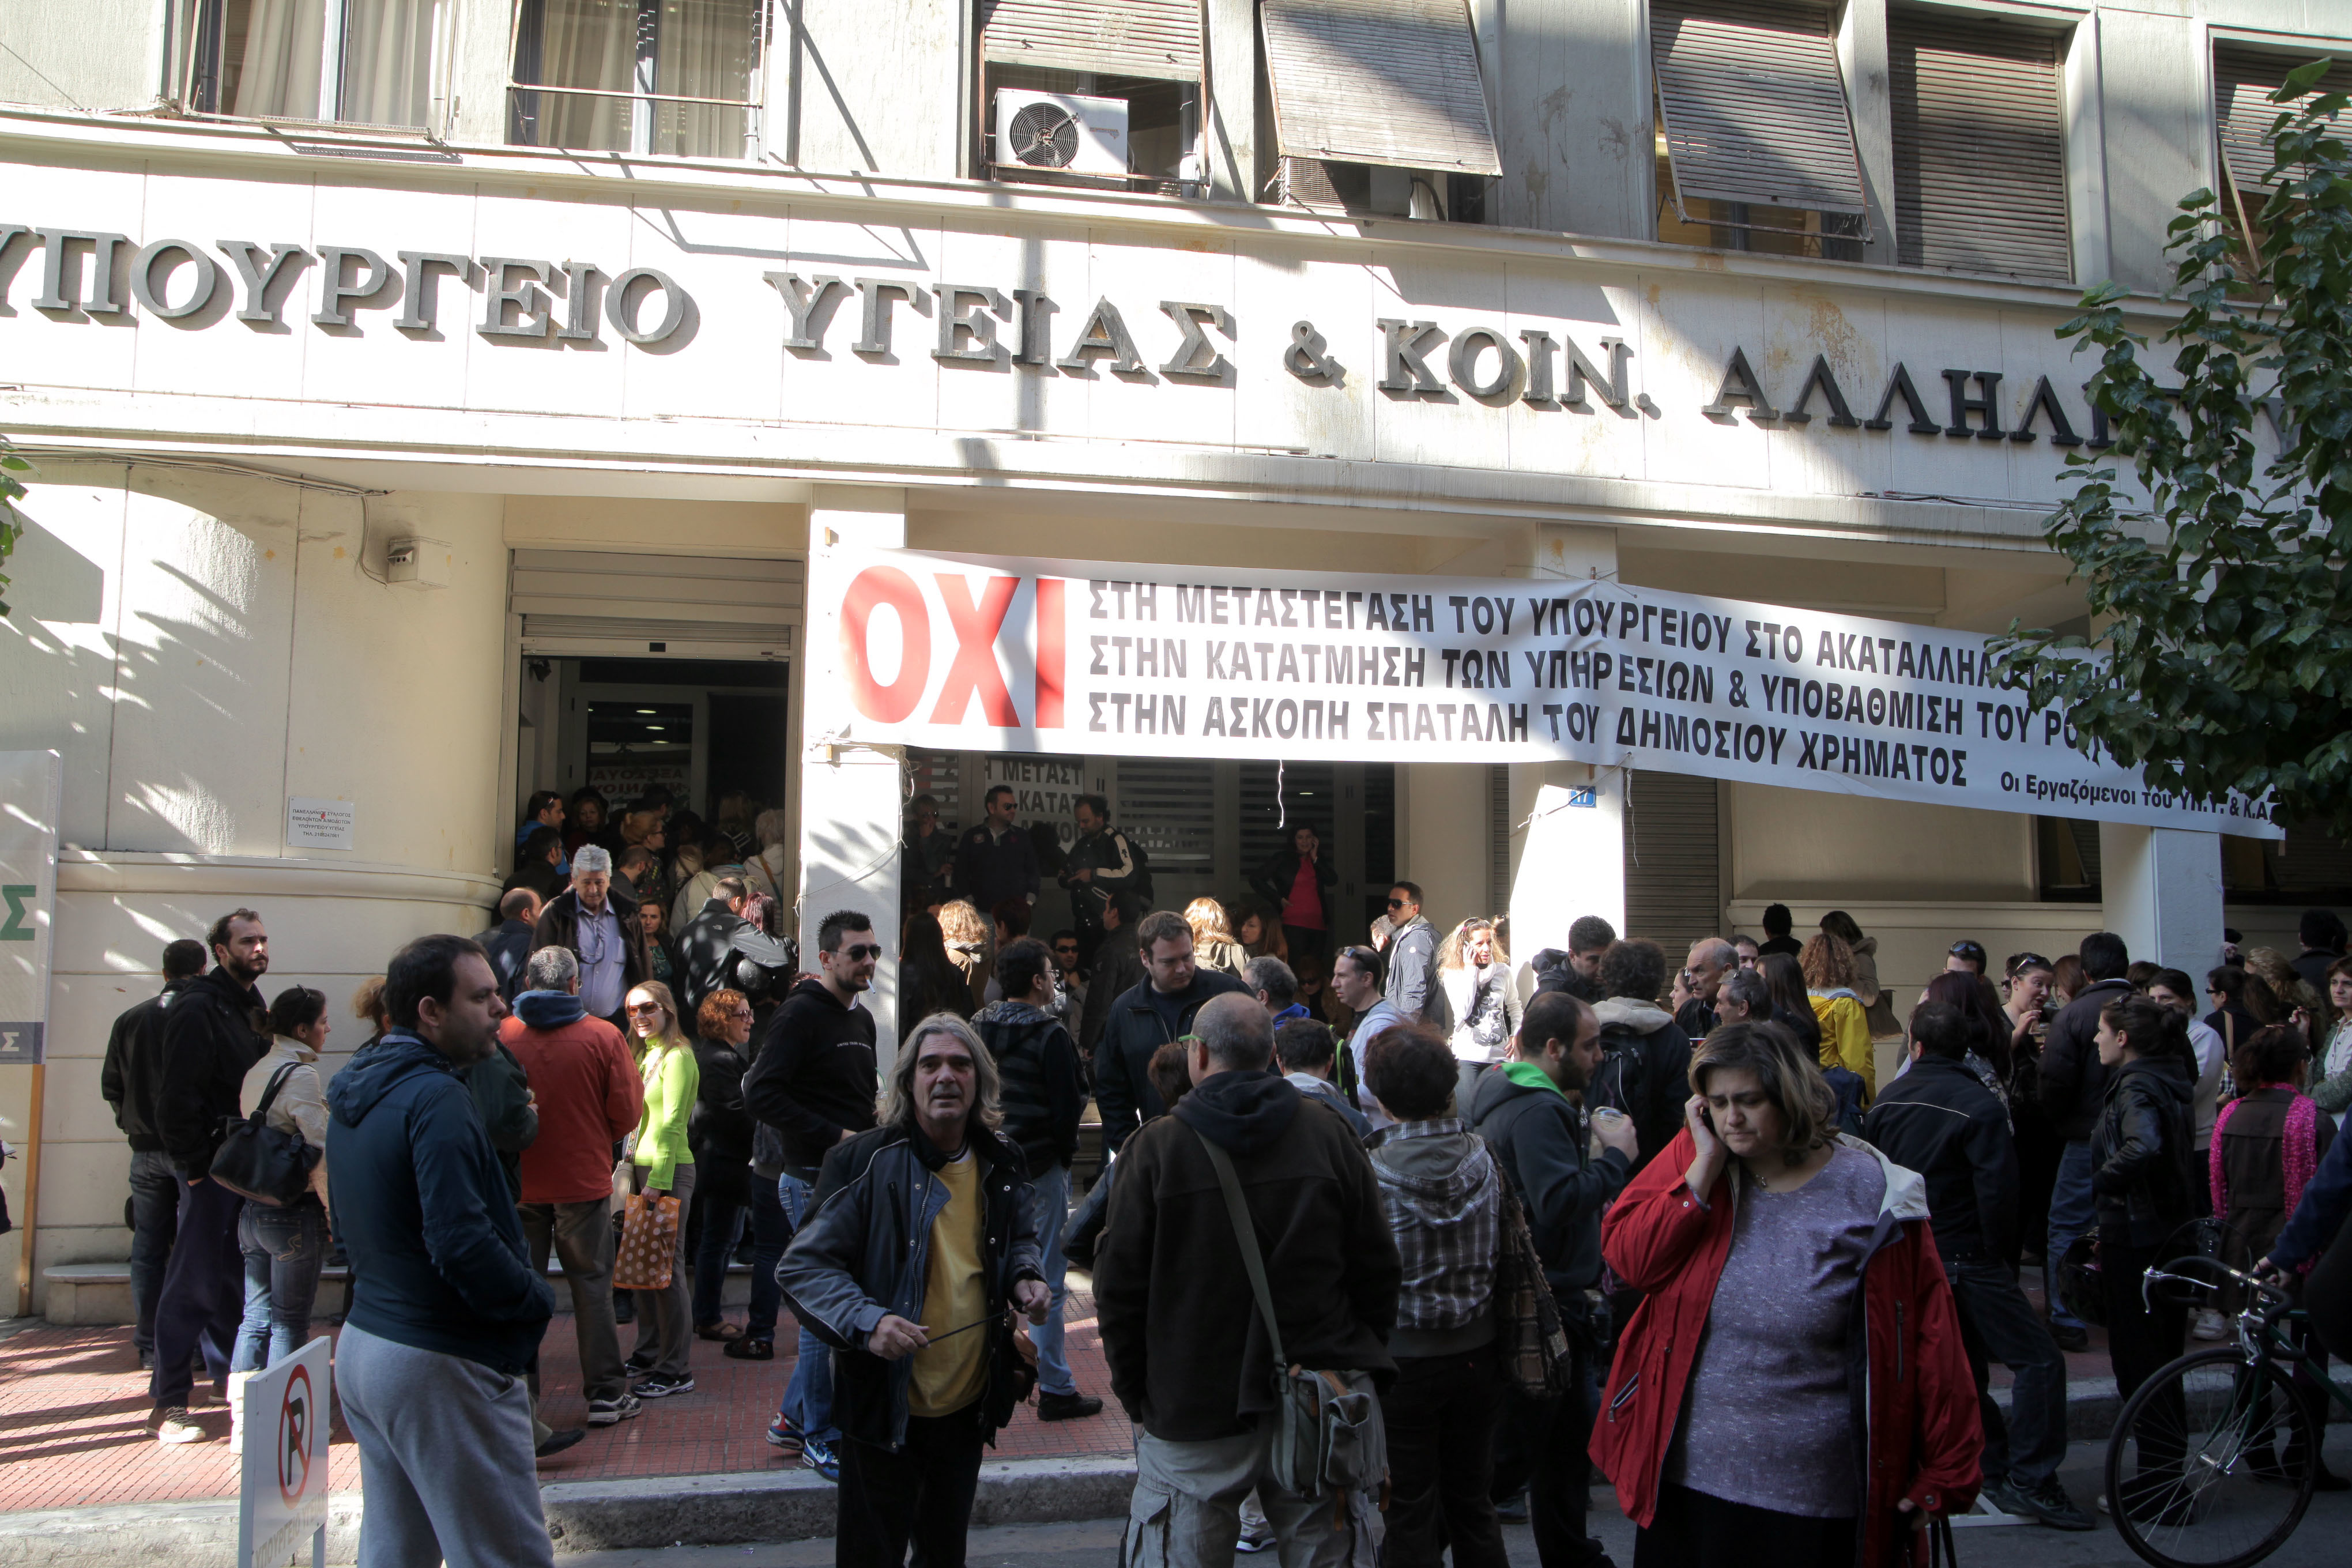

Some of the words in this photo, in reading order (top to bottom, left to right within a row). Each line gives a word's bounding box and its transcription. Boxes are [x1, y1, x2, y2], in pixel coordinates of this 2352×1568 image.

[762, 271, 1224, 377] ΥΓΕΙΑΣ
[1283, 320, 1335, 379] &
[1375, 318, 1652, 409] ΚΟΙΝ.
[839, 564, 1065, 729] ΟΧΙ
[1089, 579, 1157, 621] ΣΤΗ
[1176, 584, 1433, 633] ΜΕΤΑΣΤΕΓΑΣΗ
[1449, 596, 1515, 635] ΤΟΥ
[1528, 598, 1732, 653] ΥΠΟΥΡΓΕΙΟΥ
[1744, 620, 1803, 664] ΣΤΟ
[1088, 692, 1185, 736] ΣΤΗΝ
[1203, 696, 1350, 740] ΑΣΚΟΠΗ
[1367, 703, 1528, 742] ΣΠΑΤΑΛΗ
[1543, 704, 1600, 744] ΤΟΥ
[1615, 707, 1787, 765] ΔΗΜΟΣΙΟΥ
[1796, 730, 1967, 786] ΧΡΗΜΑΤΟΣ
[1089, 635, 1187, 679] ΣΤΗΝ
[1205, 640, 1425, 688] ΚΑΤΑΤΜΗΣΗ
[1442, 649, 1510, 689] ΤΩΝ
[1525, 650, 1714, 704] ΥΠΗΡΕΣΙΩΝ
[1729, 670, 1750, 708] &
[1761, 673, 1963, 736] ΥΠΟΒΑΘΜΙΣΗ
[1976, 702, 2031, 743] ΤΟΥ
[2000, 771, 2019, 792] Οι
[2026, 774, 2136, 806] Εργαζόμενοι
[2140, 791, 2173, 809] του
[2229, 797, 2240, 816] &
